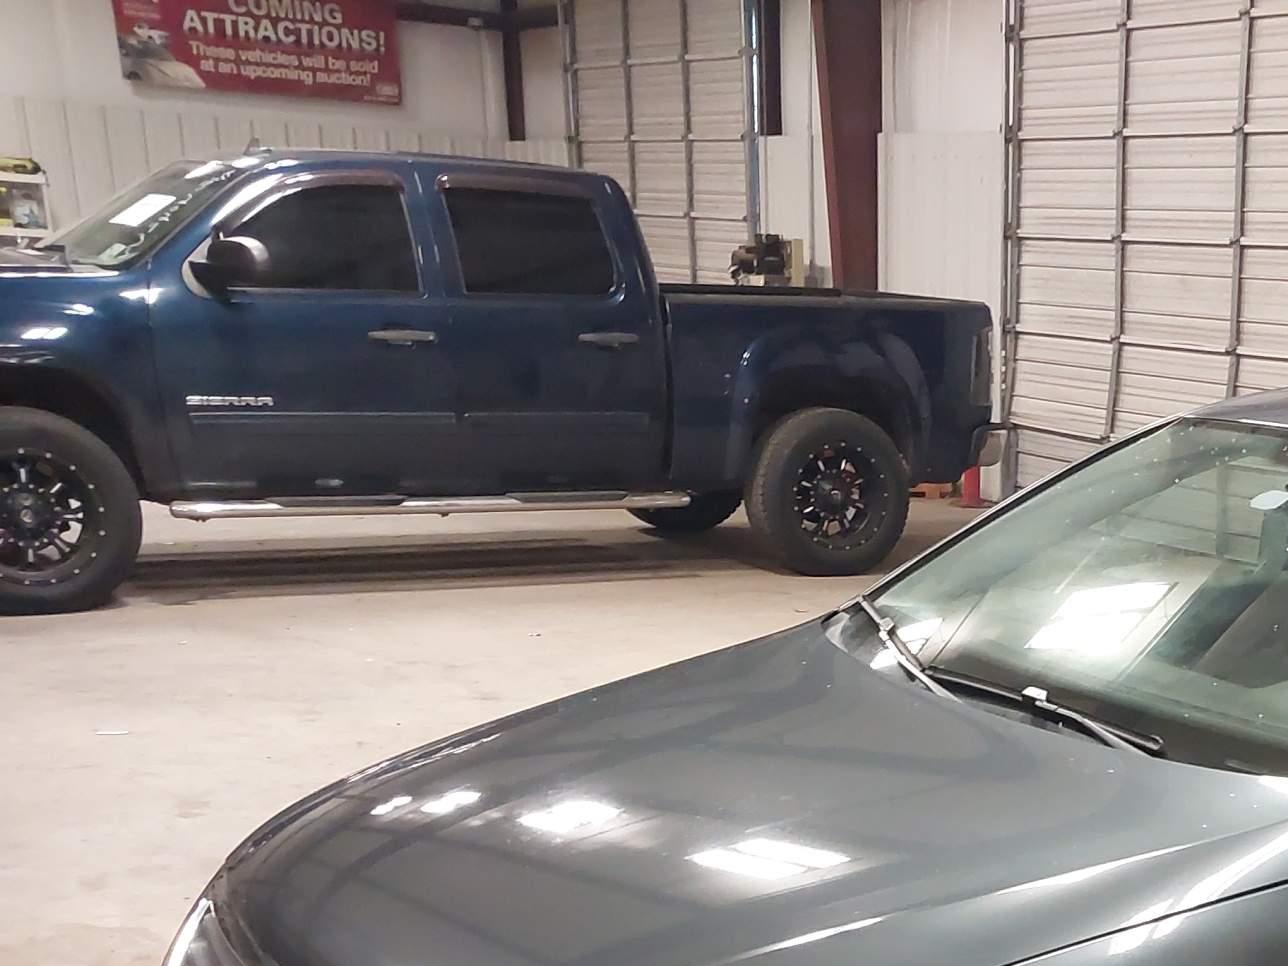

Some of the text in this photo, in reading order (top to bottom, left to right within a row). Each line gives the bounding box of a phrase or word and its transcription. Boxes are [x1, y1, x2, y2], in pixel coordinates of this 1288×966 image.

[227, 0, 343, 25] COMING
[183, 9, 385, 54] ATTRACTIONS!
[188, 40, 379, 74] These vehicles will be sold
[200, 58, 371, 87] at an upcoming auction!
[185, 395, 274, 407] SIERRA
